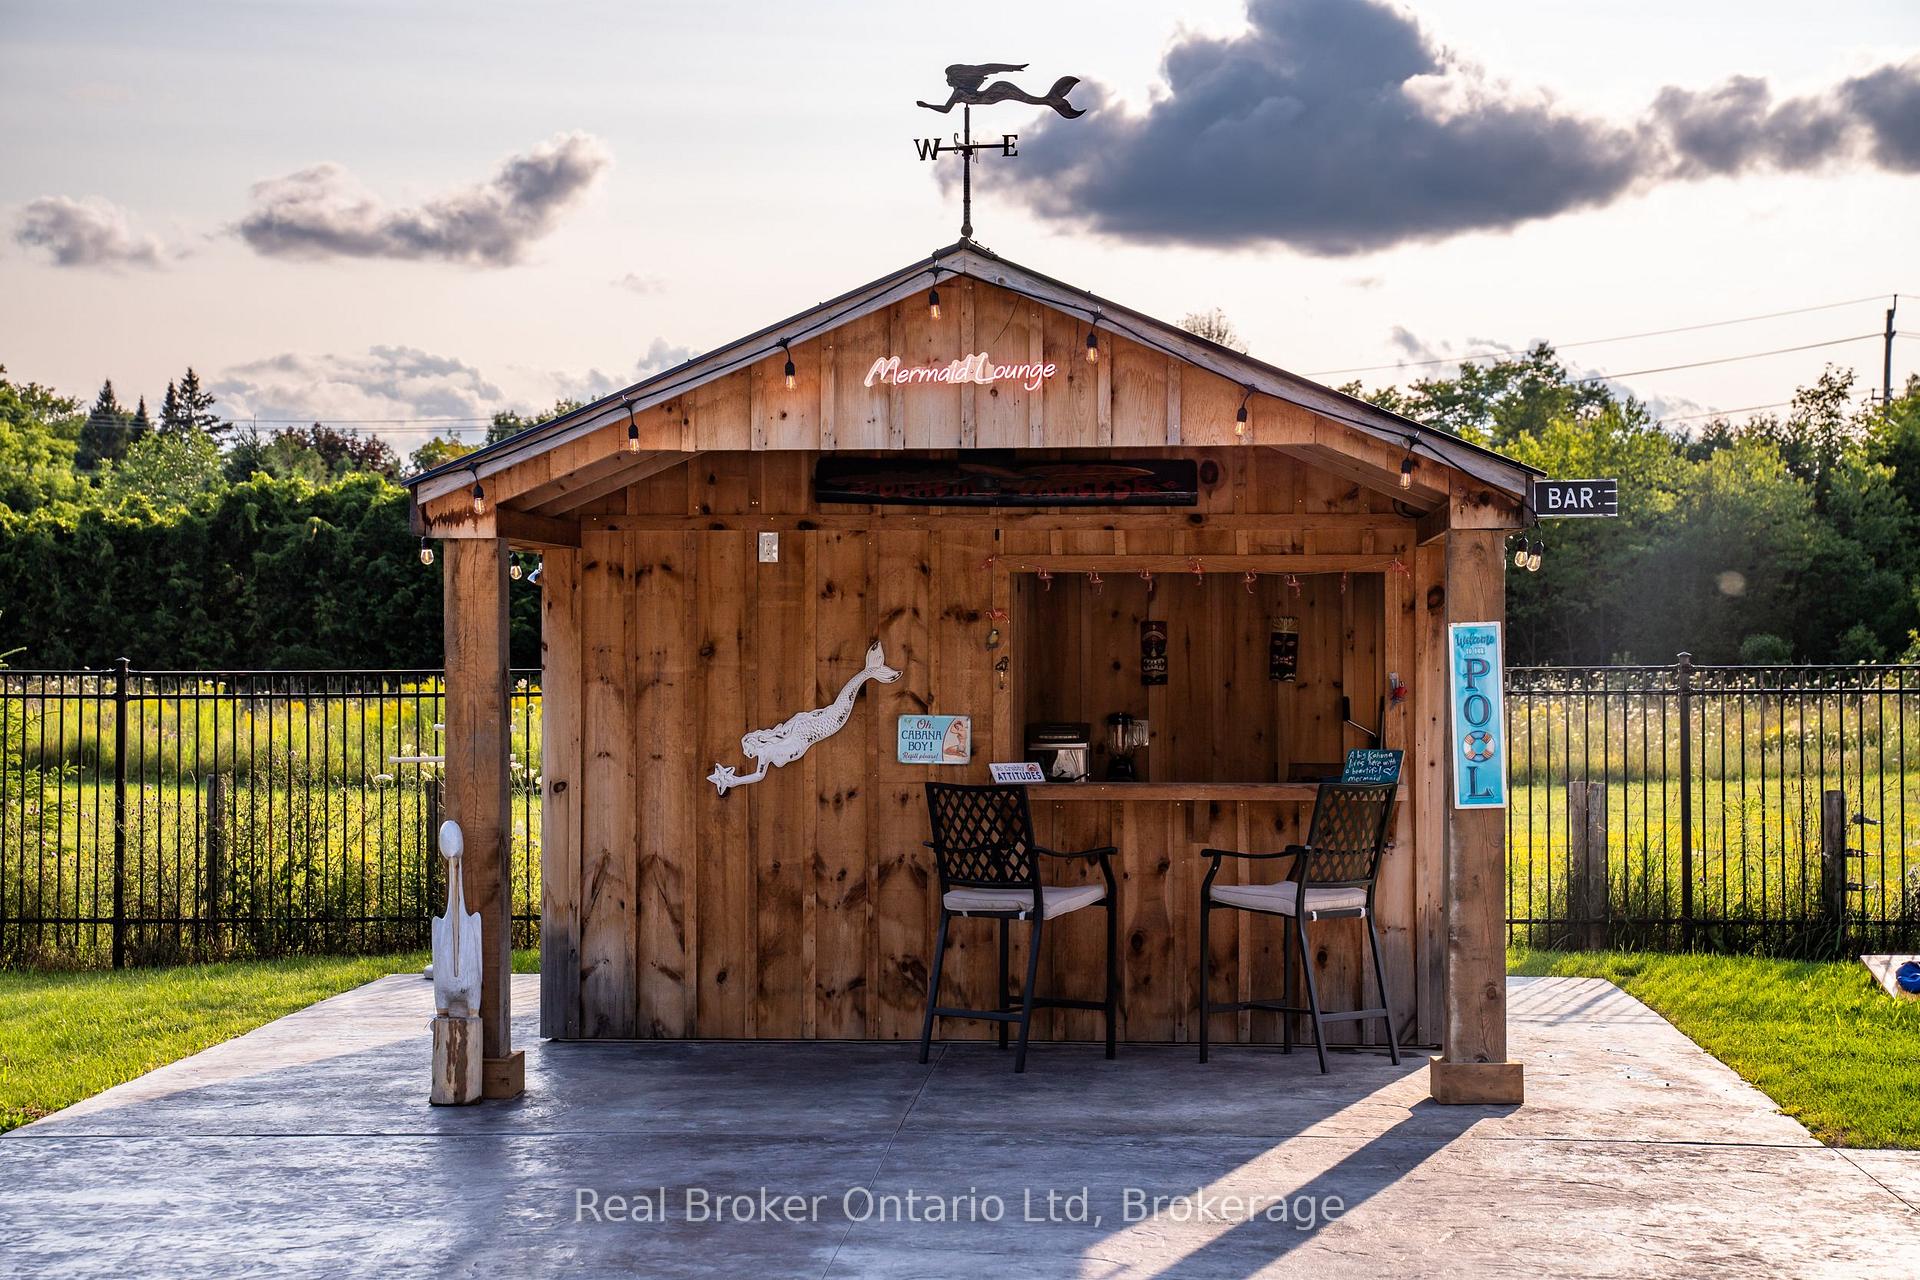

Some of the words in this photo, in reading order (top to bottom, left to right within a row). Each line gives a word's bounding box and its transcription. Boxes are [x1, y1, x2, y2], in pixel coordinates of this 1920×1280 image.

[913, 138, 942, 161] W
[1002, 134, 1018, 157] E
[864, 353, 973, 387] Mermaid
[975, 351, 1056, 391] Lounge
[1548, 487, 1594, 509] BAR
[901, 730, 942, 740] CABANA
[908, 741, 933, 751] BOY!
[997, 772, 1042, 781] ATTITUDES
